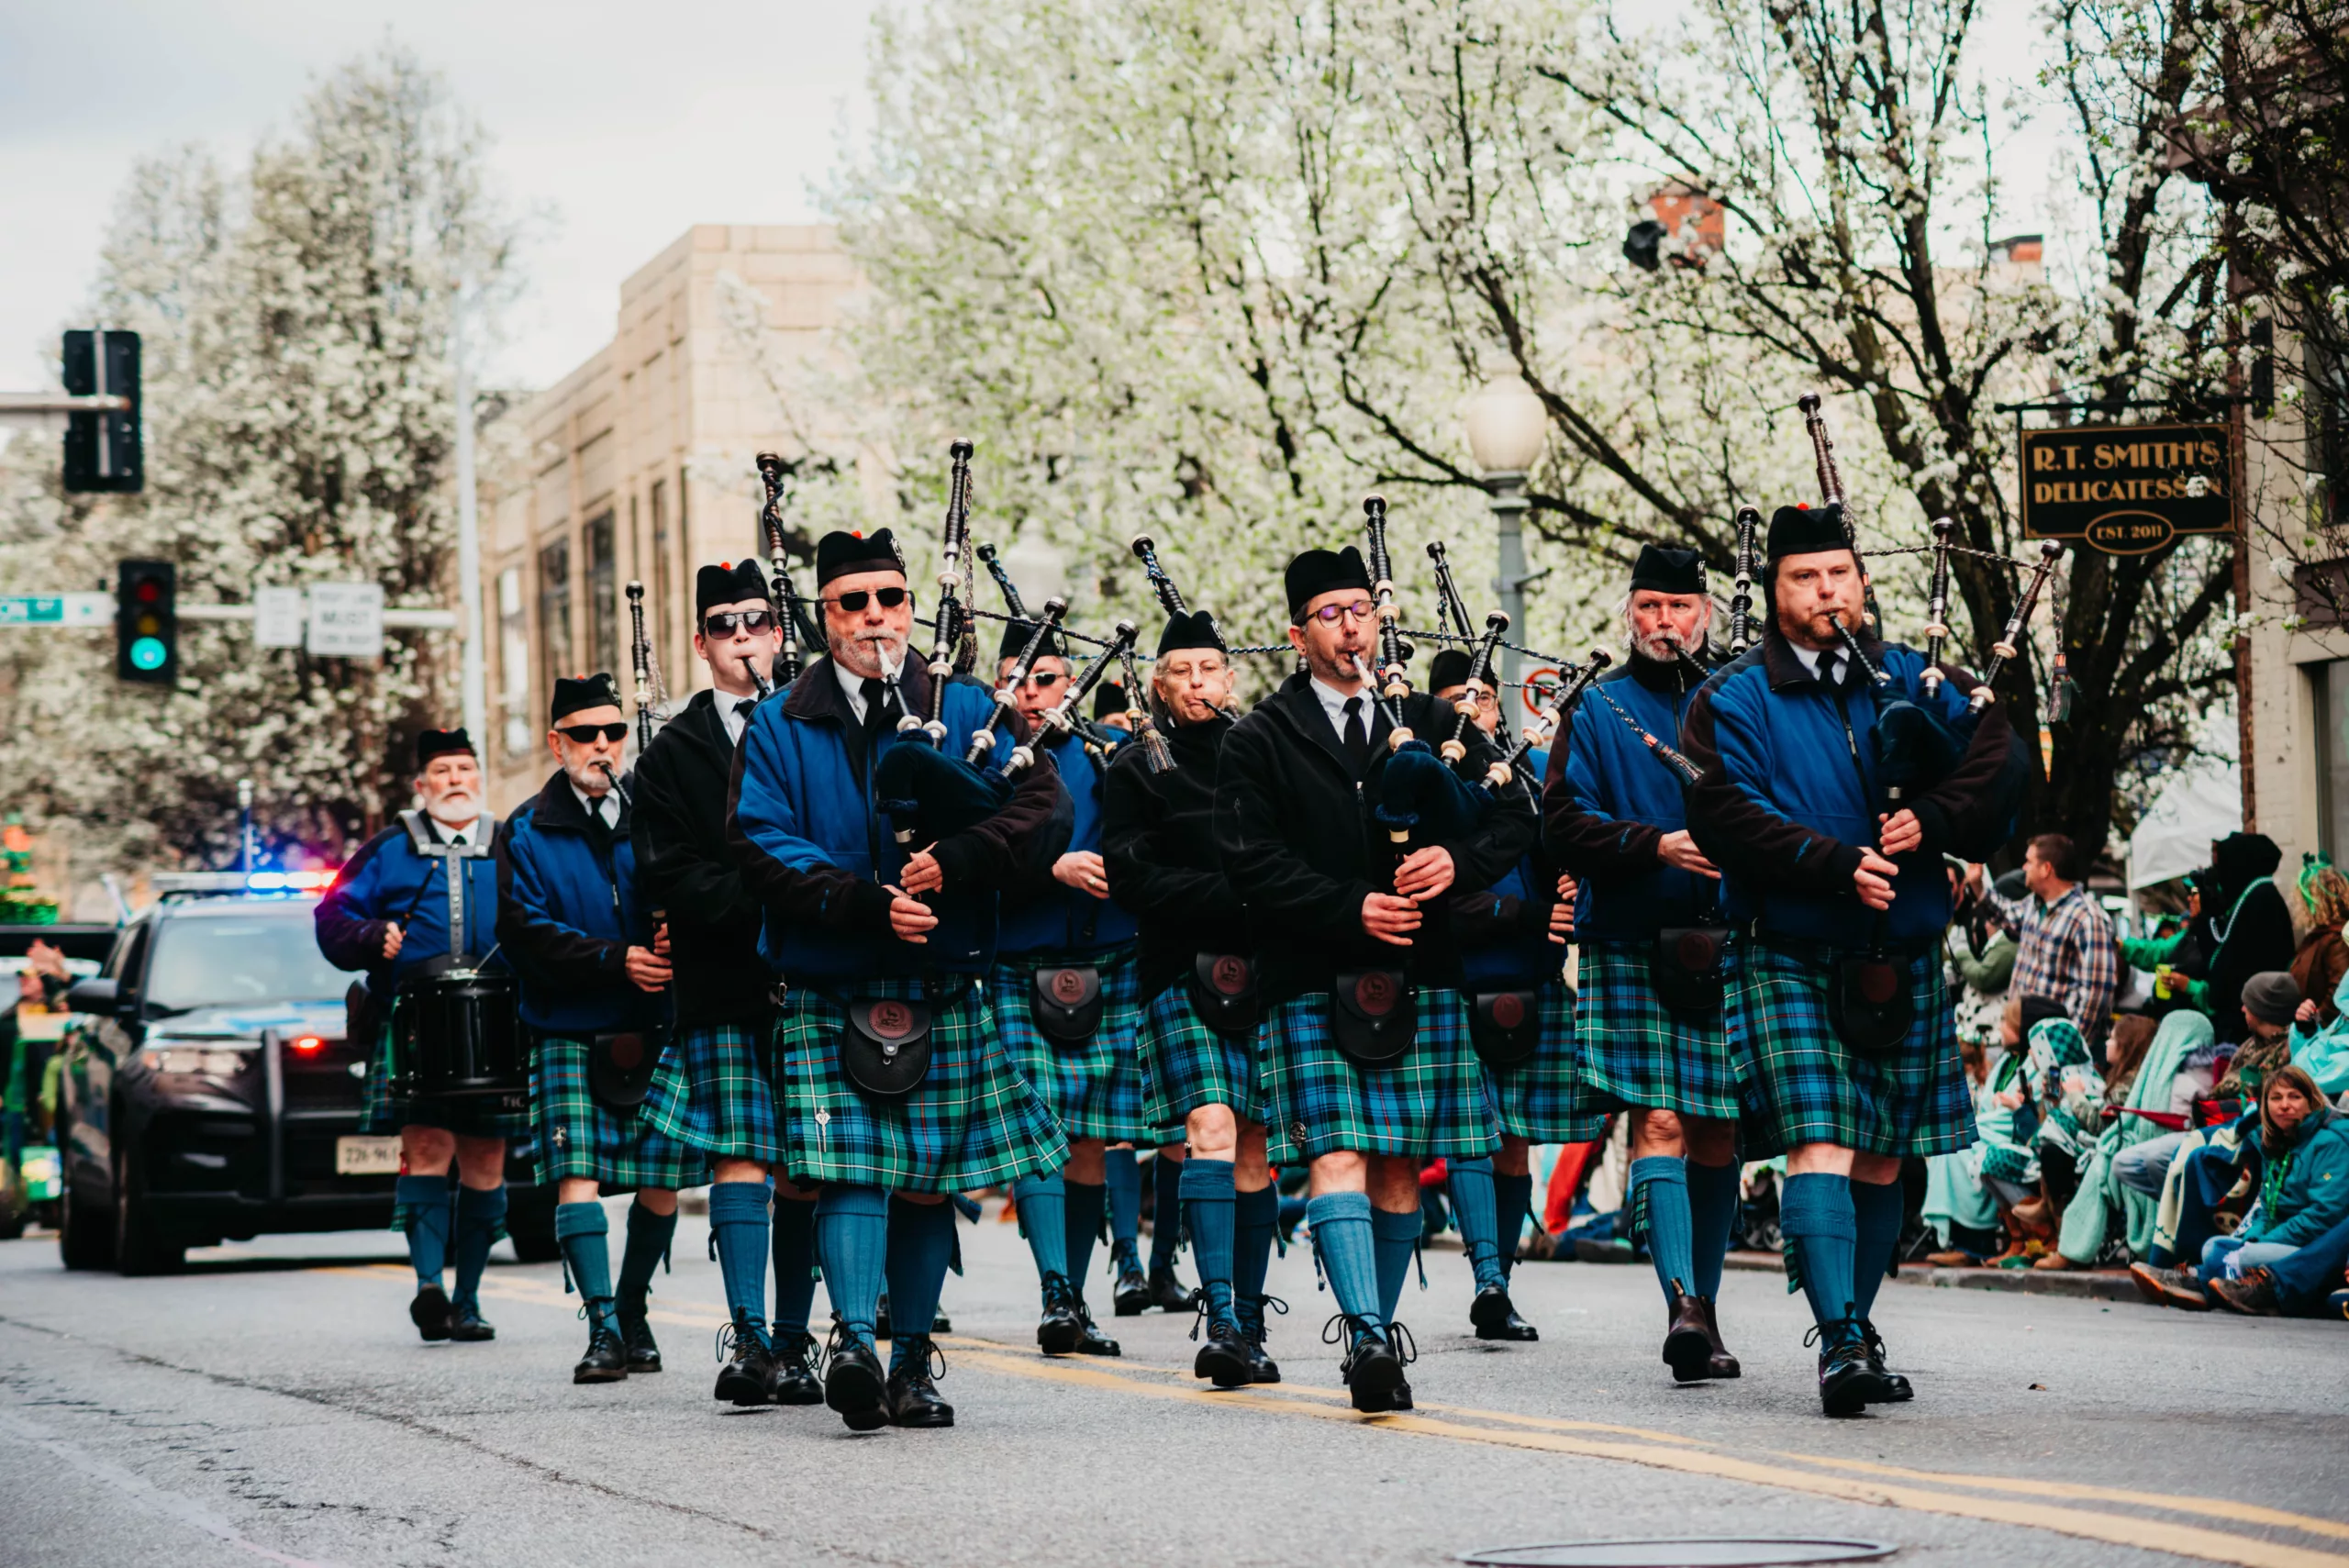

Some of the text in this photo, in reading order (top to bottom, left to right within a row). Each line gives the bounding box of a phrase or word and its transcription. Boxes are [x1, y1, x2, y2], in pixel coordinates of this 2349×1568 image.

[2033, 441, 2220, 471] R.T. SMITH'S
[2034, 478, 2221, 503] DELICATESSN
[2096, 524, 2163, 540] EST. 2011
